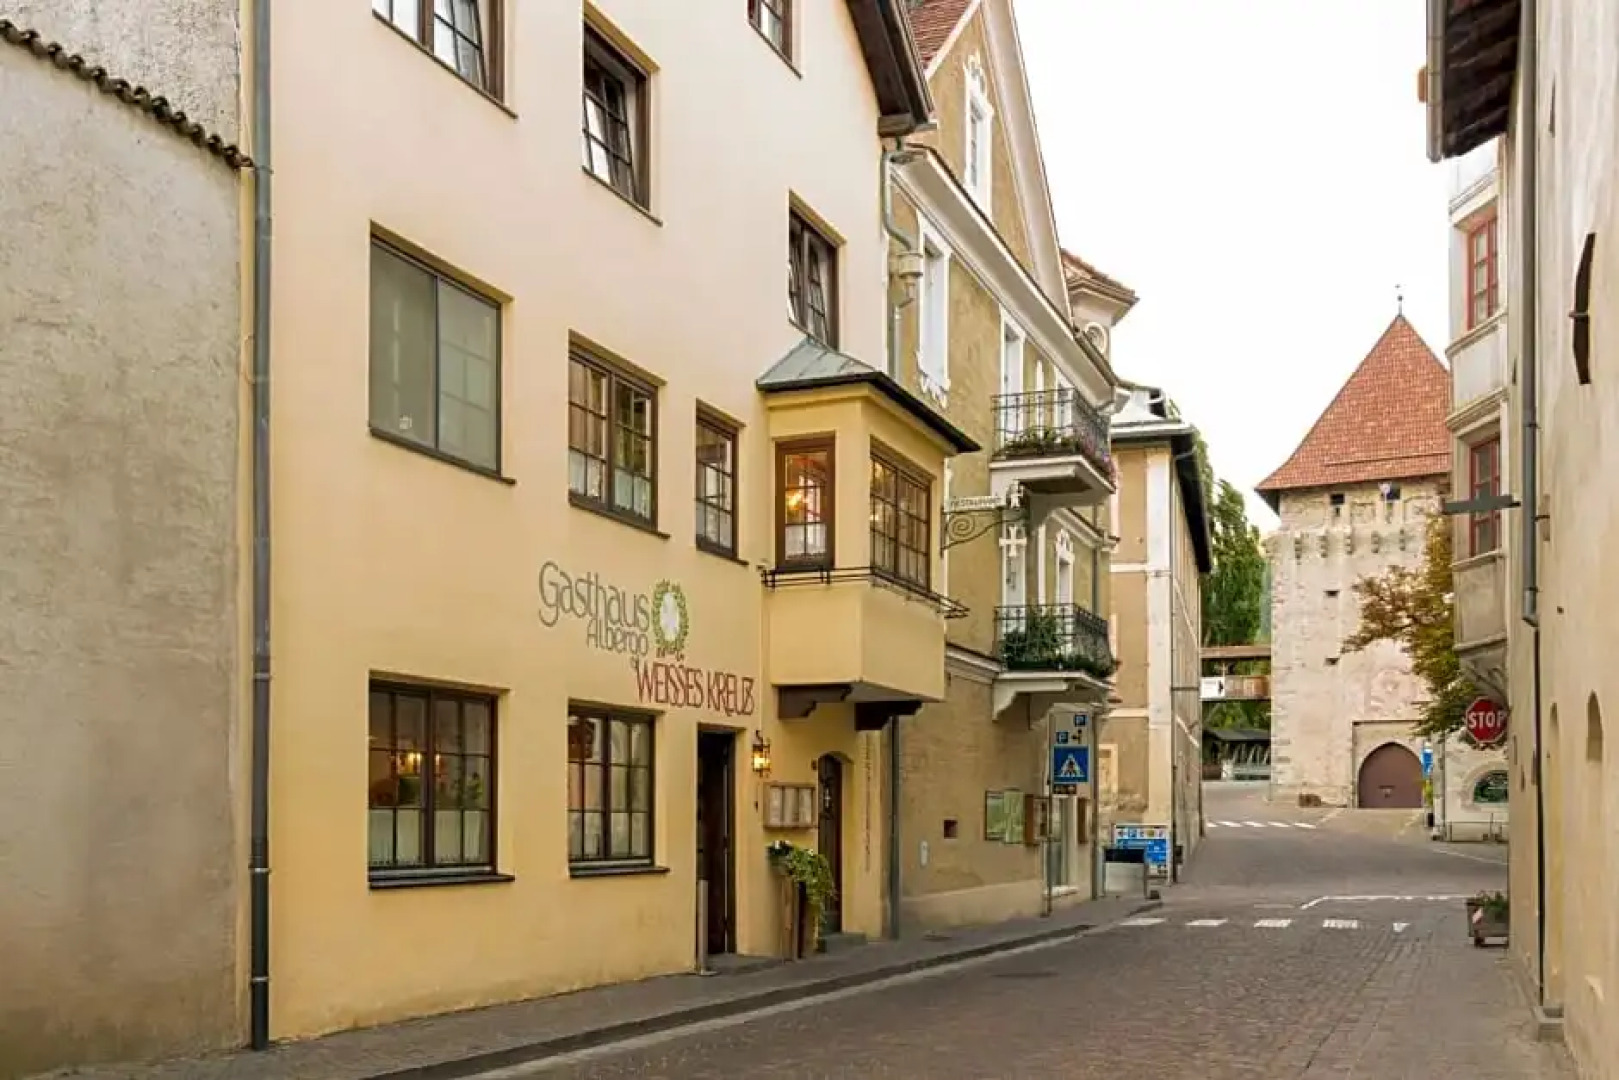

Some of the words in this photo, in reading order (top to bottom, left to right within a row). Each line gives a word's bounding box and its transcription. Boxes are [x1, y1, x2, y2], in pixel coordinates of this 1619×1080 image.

[538, 561, 650, 631] Gasthaus
[586, 616, 649, 656] Albergo
[634, 658, 704, 708] WEISSES
[1468, 710, 1507, 729] STOP
